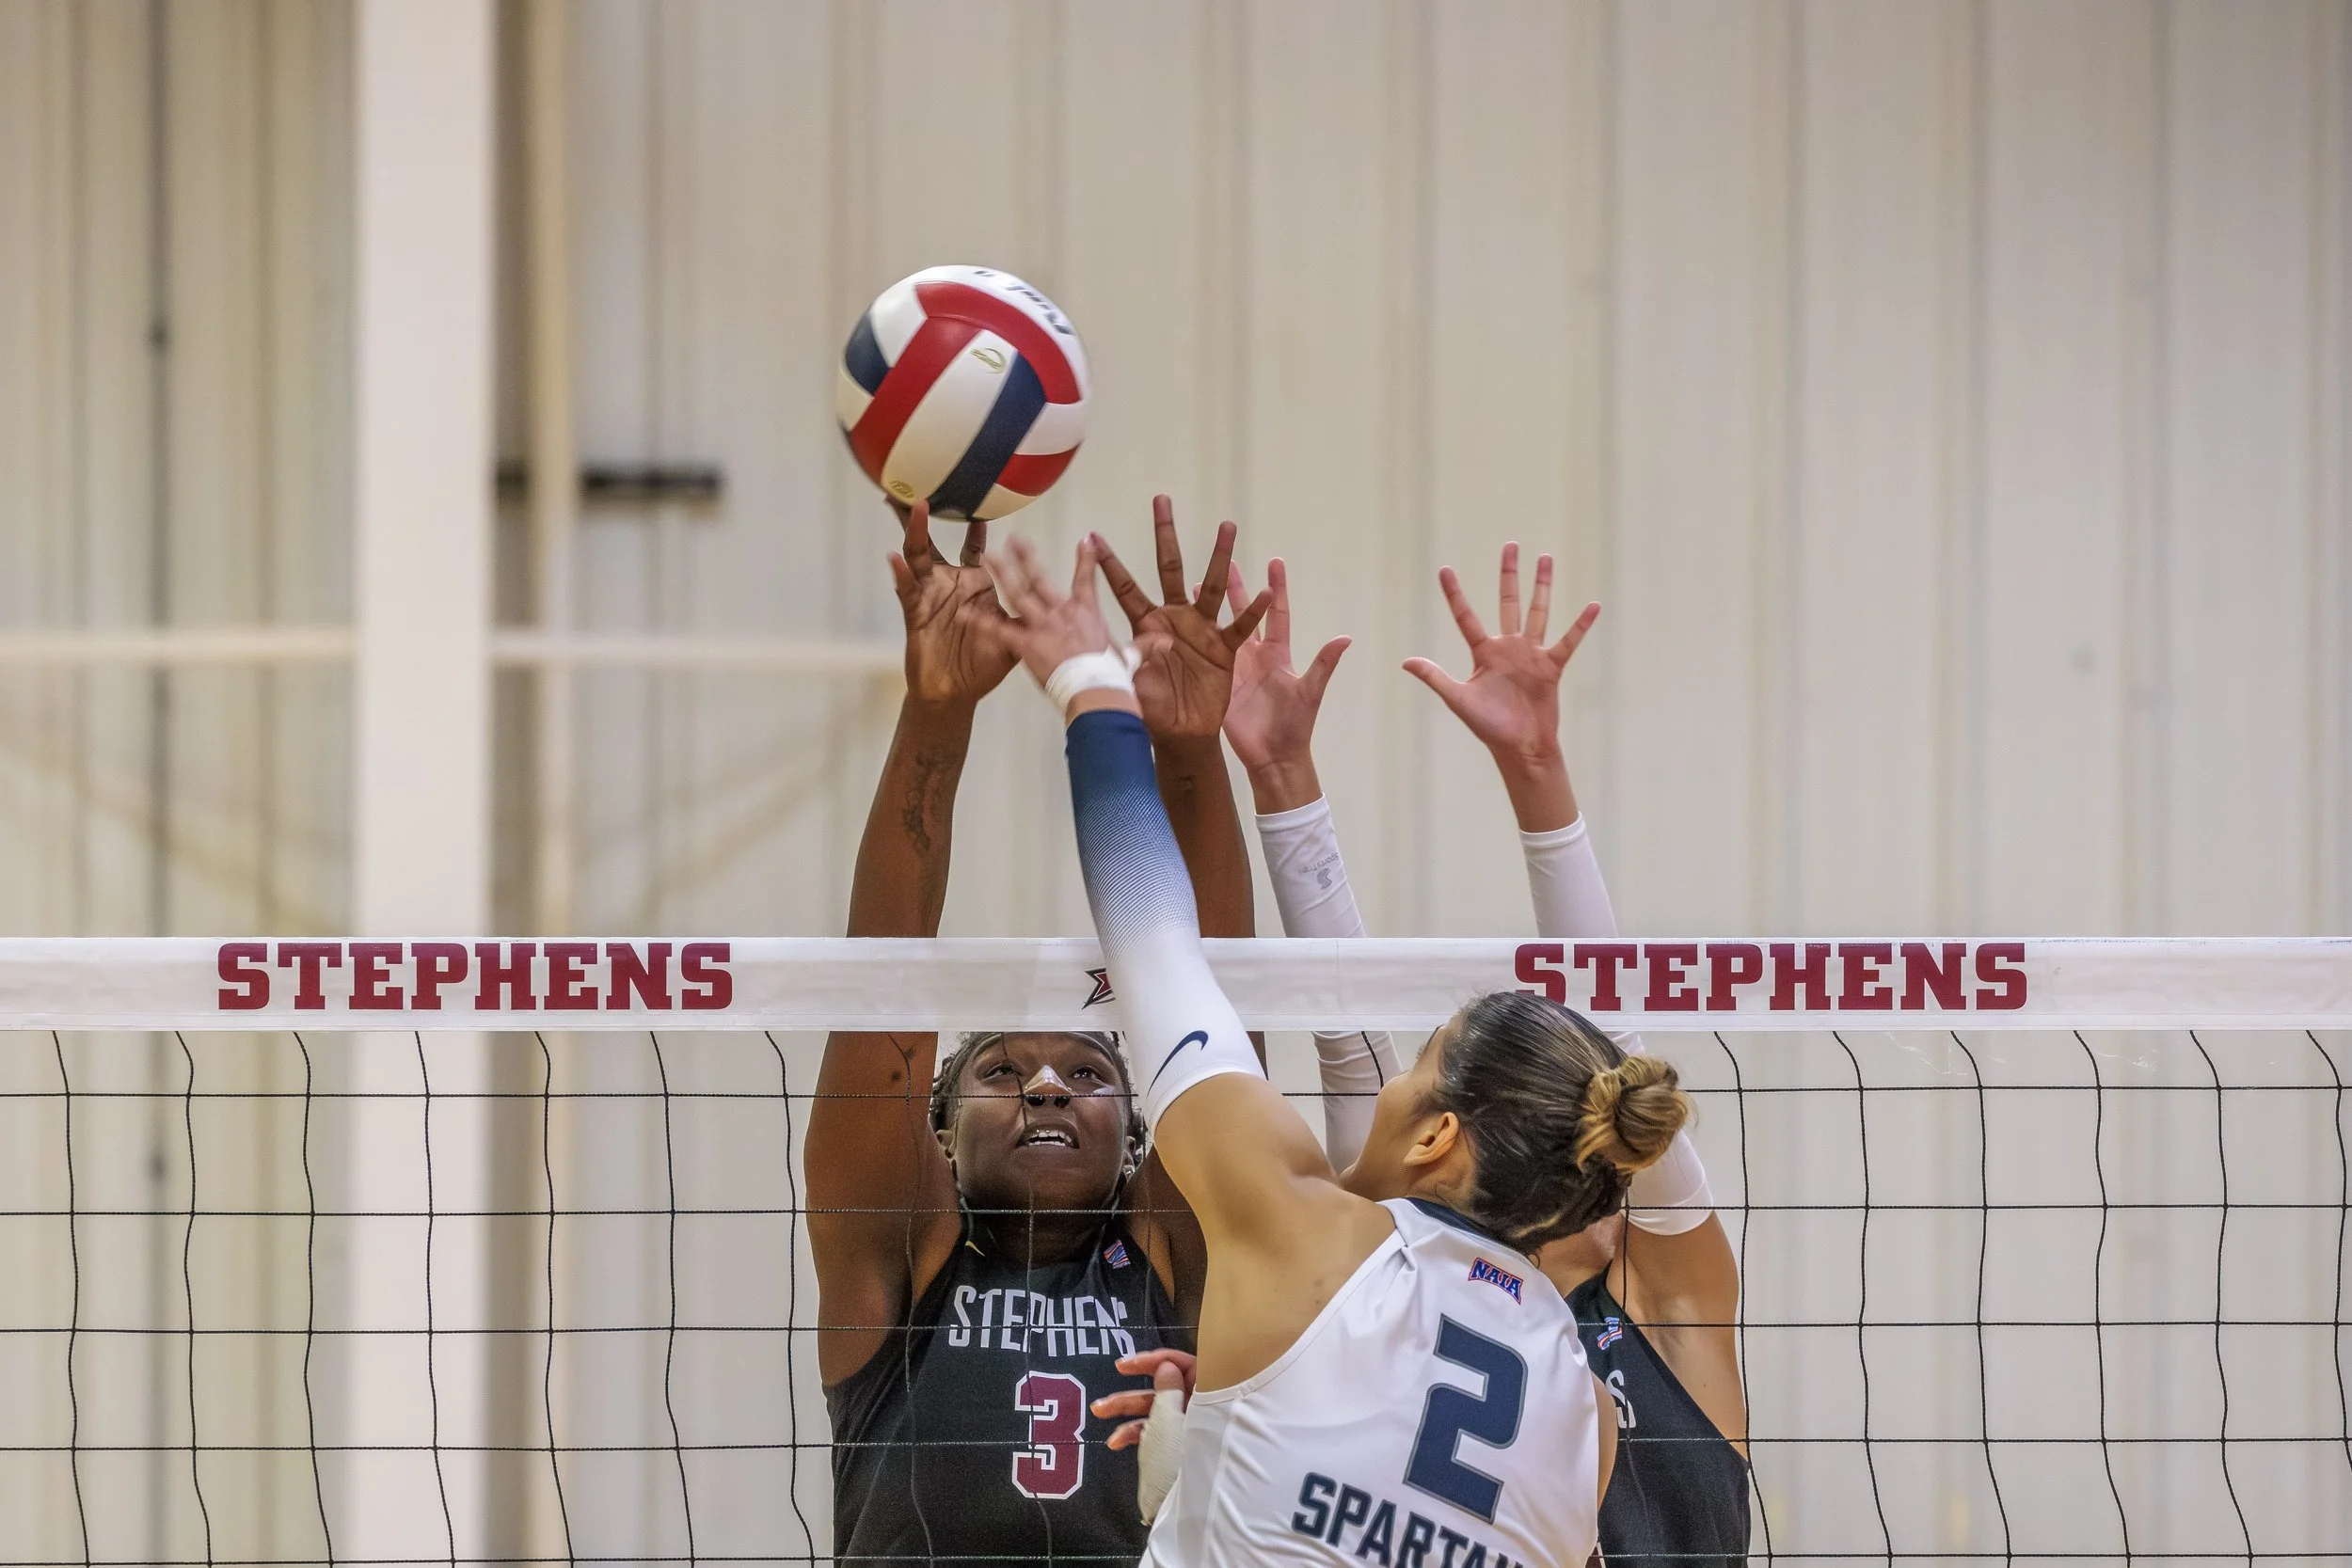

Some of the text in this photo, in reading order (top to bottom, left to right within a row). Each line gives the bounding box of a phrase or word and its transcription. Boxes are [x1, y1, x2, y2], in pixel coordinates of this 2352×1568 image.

[217, 942, 733, 1010] STEPHENS
[1514, 942, 2027, 1012] STEPHENS
[1469, 1258, 1523, 1305] NAIA
[1011, 1370, 1086, 1499] 3
[1402, 1313, 1529, 1526] 2
[1291, 1471, 1524, 1568] SPART
